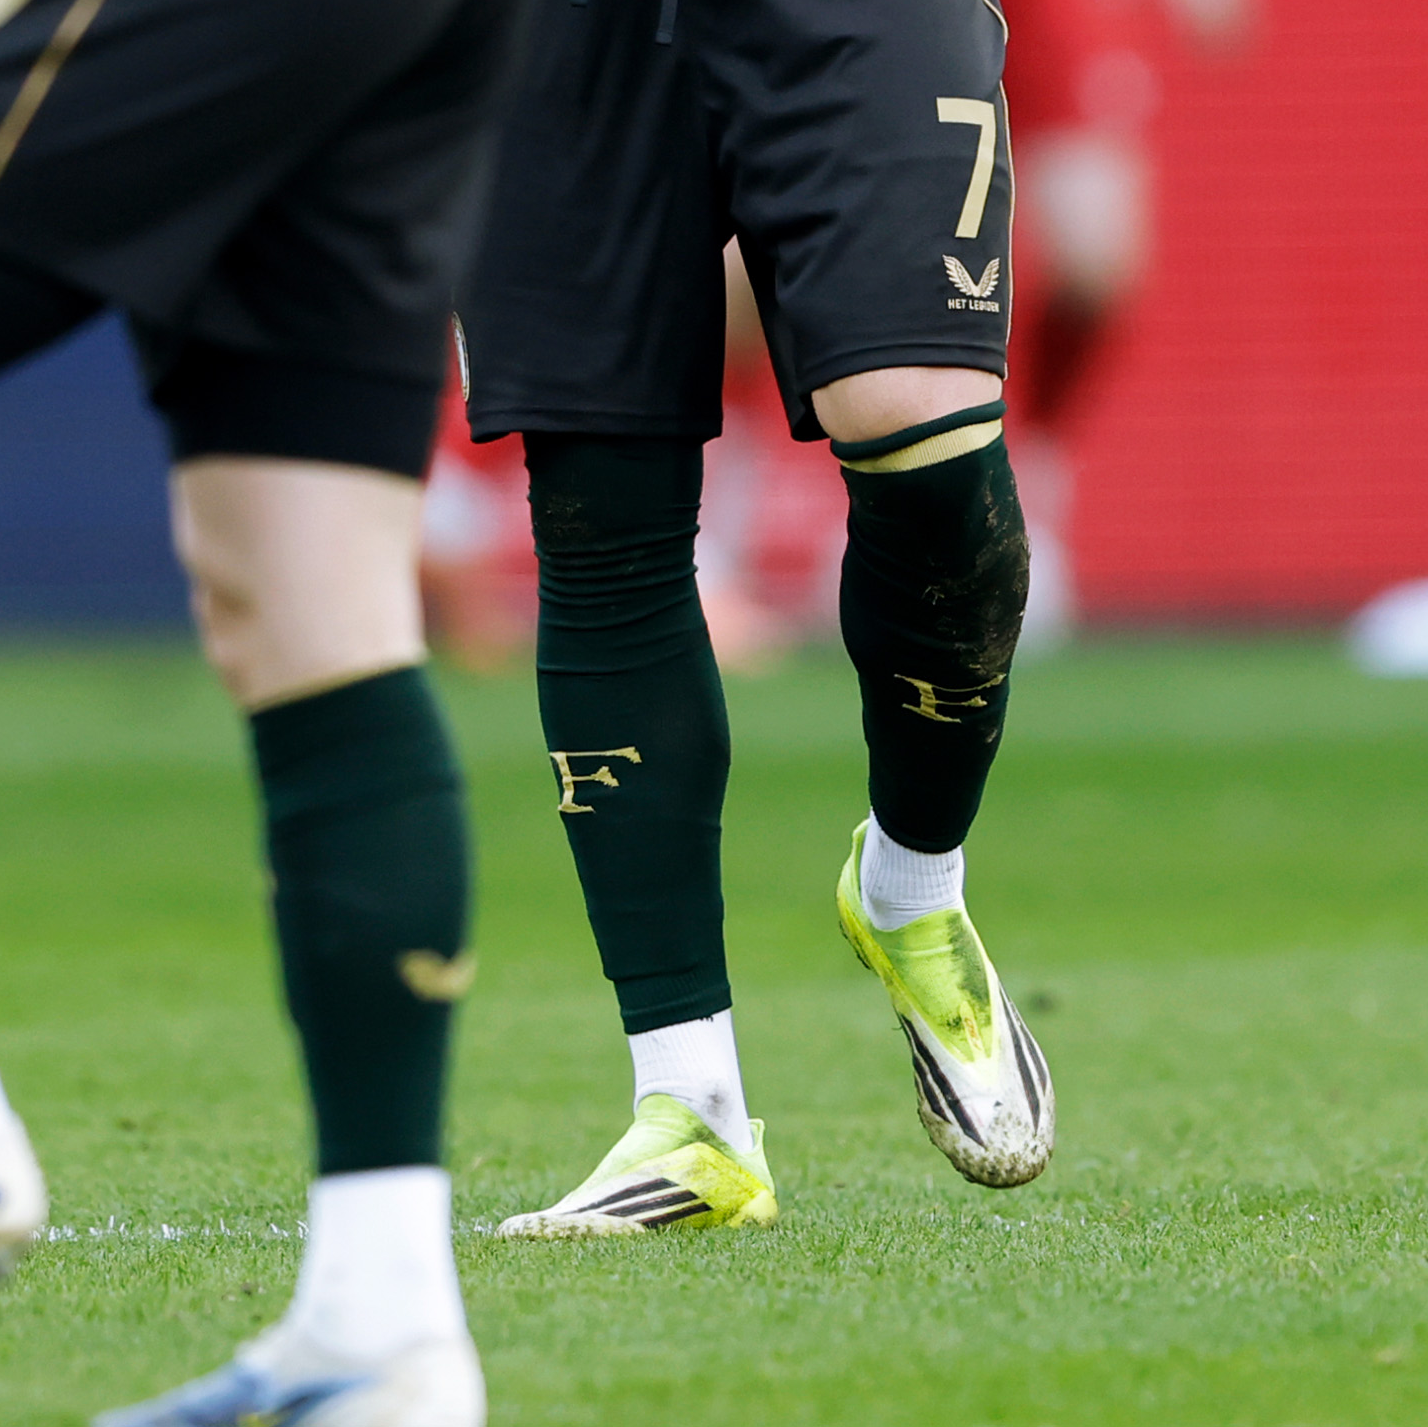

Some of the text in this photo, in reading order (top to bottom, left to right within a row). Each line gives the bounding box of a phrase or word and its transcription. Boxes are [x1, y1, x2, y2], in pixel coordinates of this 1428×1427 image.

[936, 96, 997, 239] 7
[948, 298, 967, 310] HET
[550, 745, 643, 814] F
